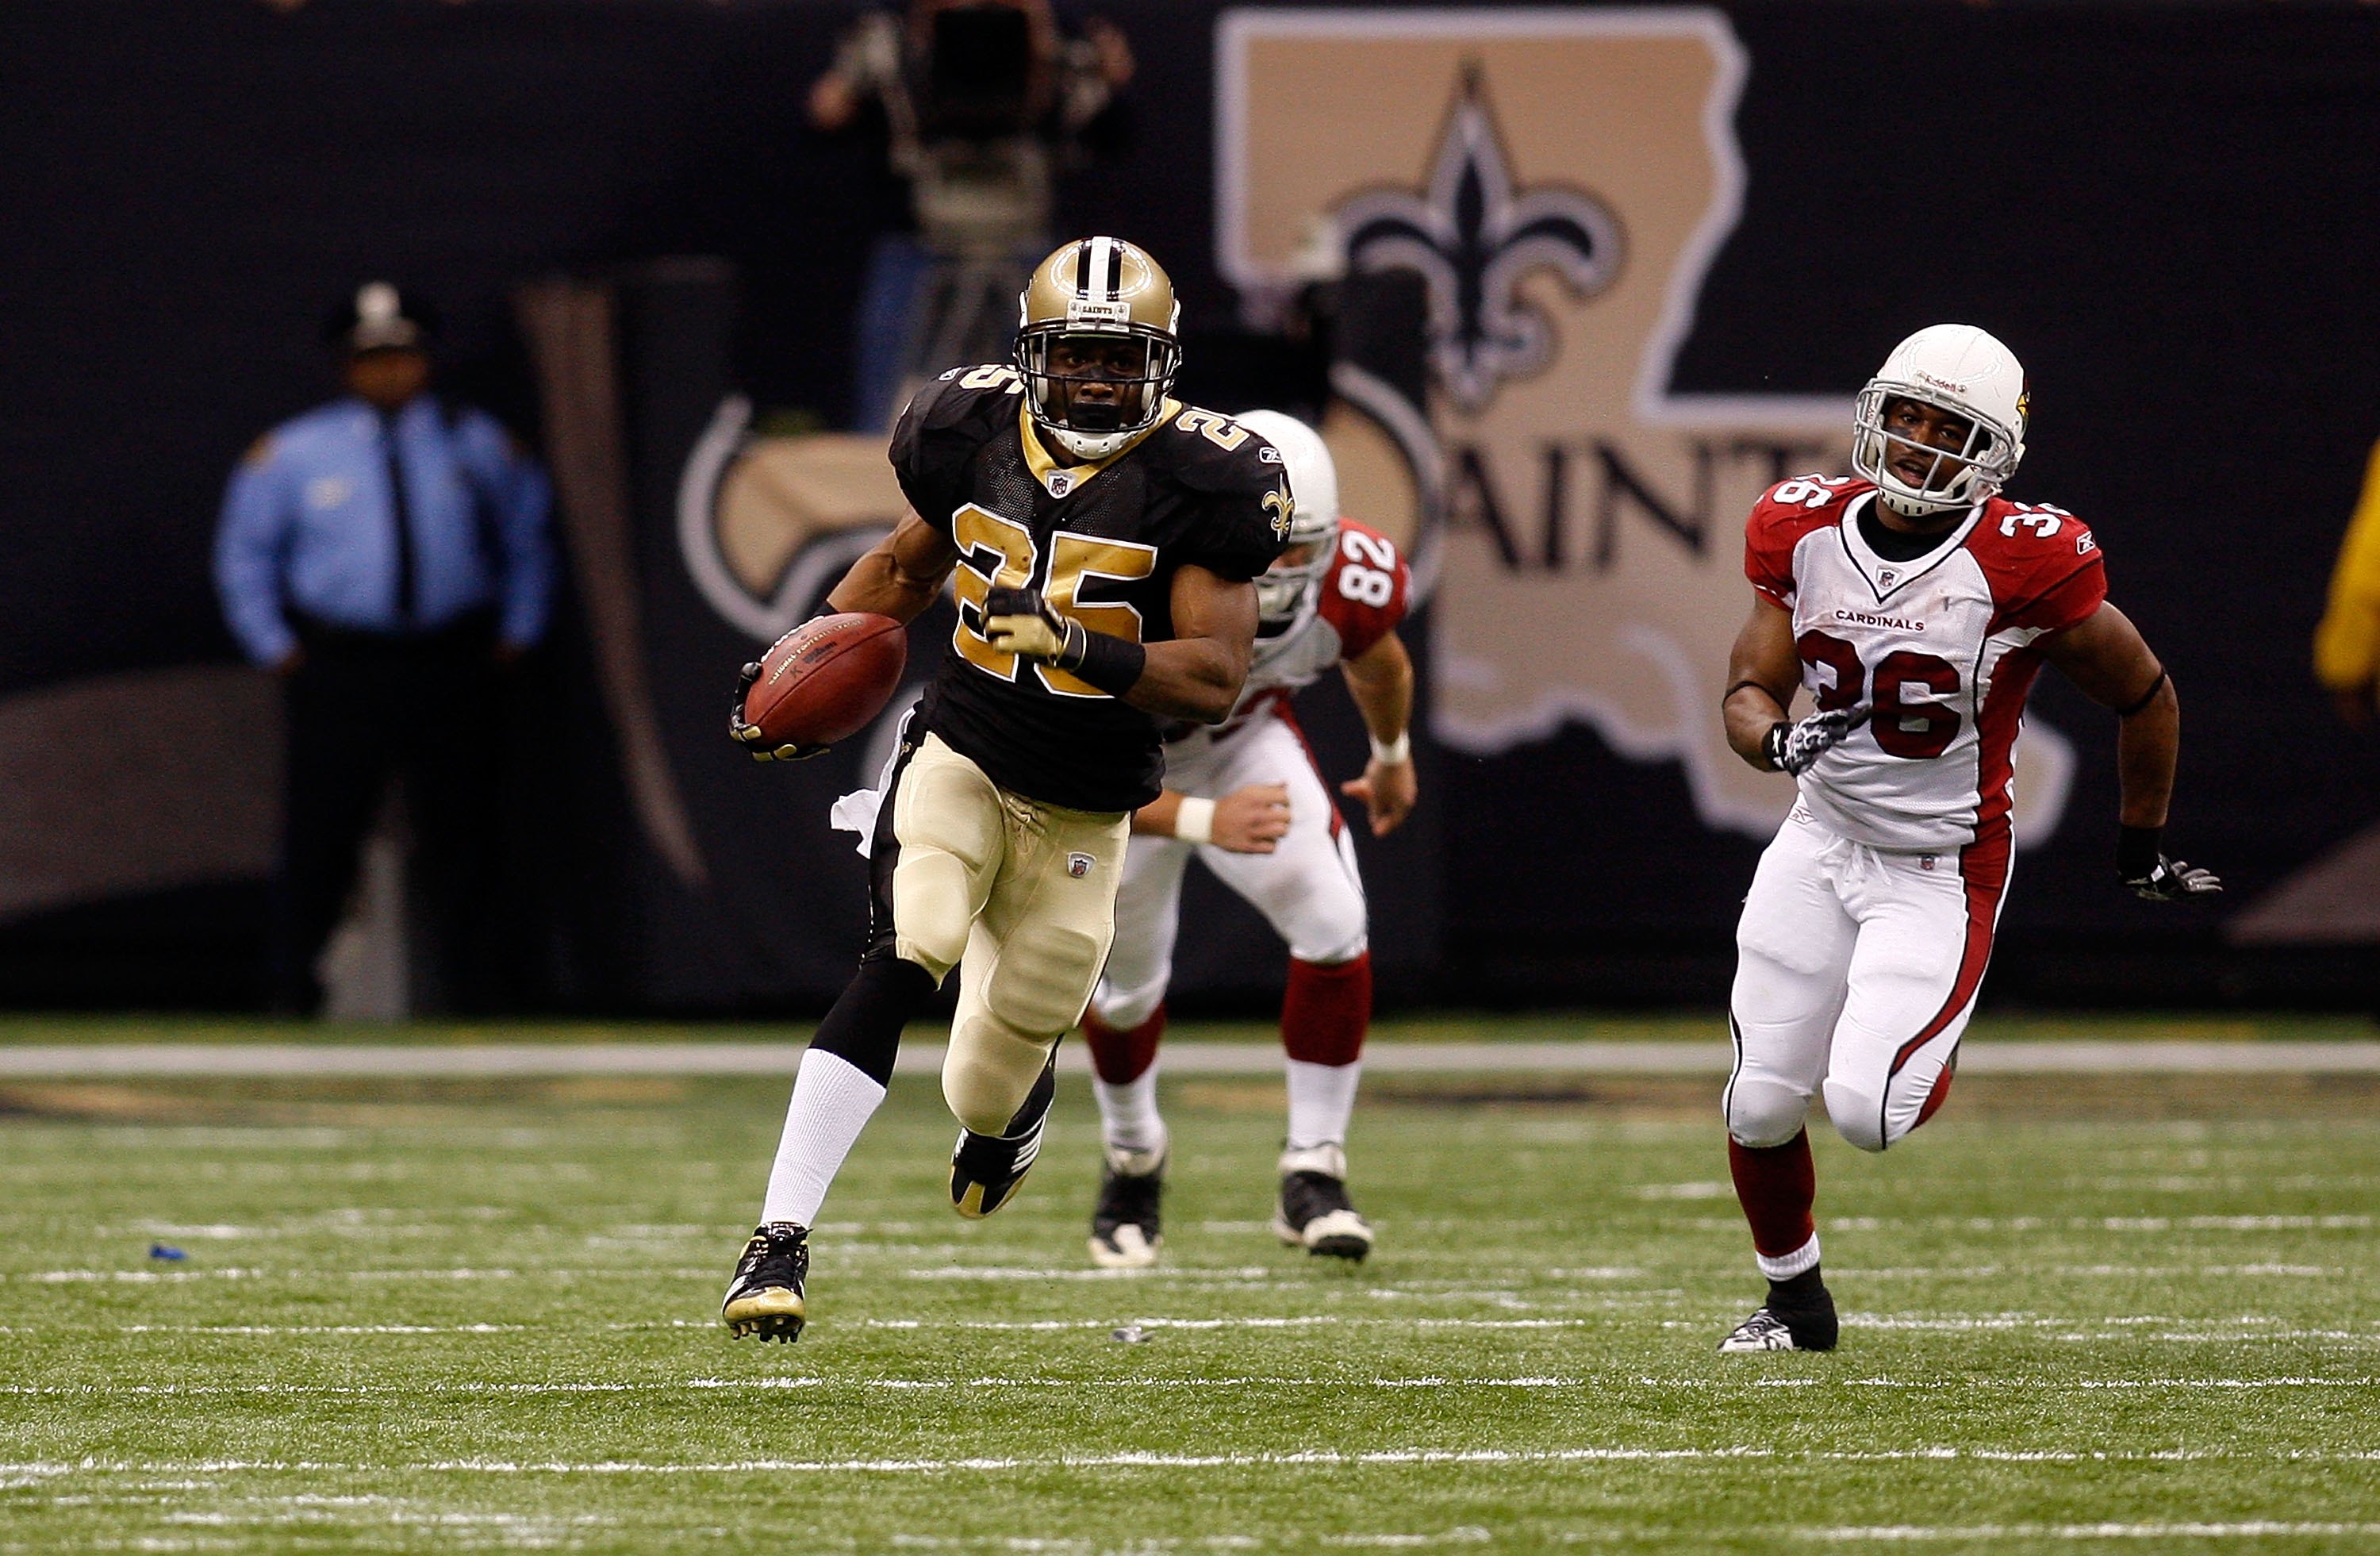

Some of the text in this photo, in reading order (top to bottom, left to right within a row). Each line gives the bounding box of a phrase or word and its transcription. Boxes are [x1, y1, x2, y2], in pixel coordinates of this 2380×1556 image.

[958, 364, 1025, 394] 5
[1175, 405, 1250, 451] 2
[1440, 436, 1833, 571] AINT
[1338, 530, 1395, 608] 82
[1835, 609, 1925, 632] CARDINALS
[1796, 628, 1962, 759] 36
